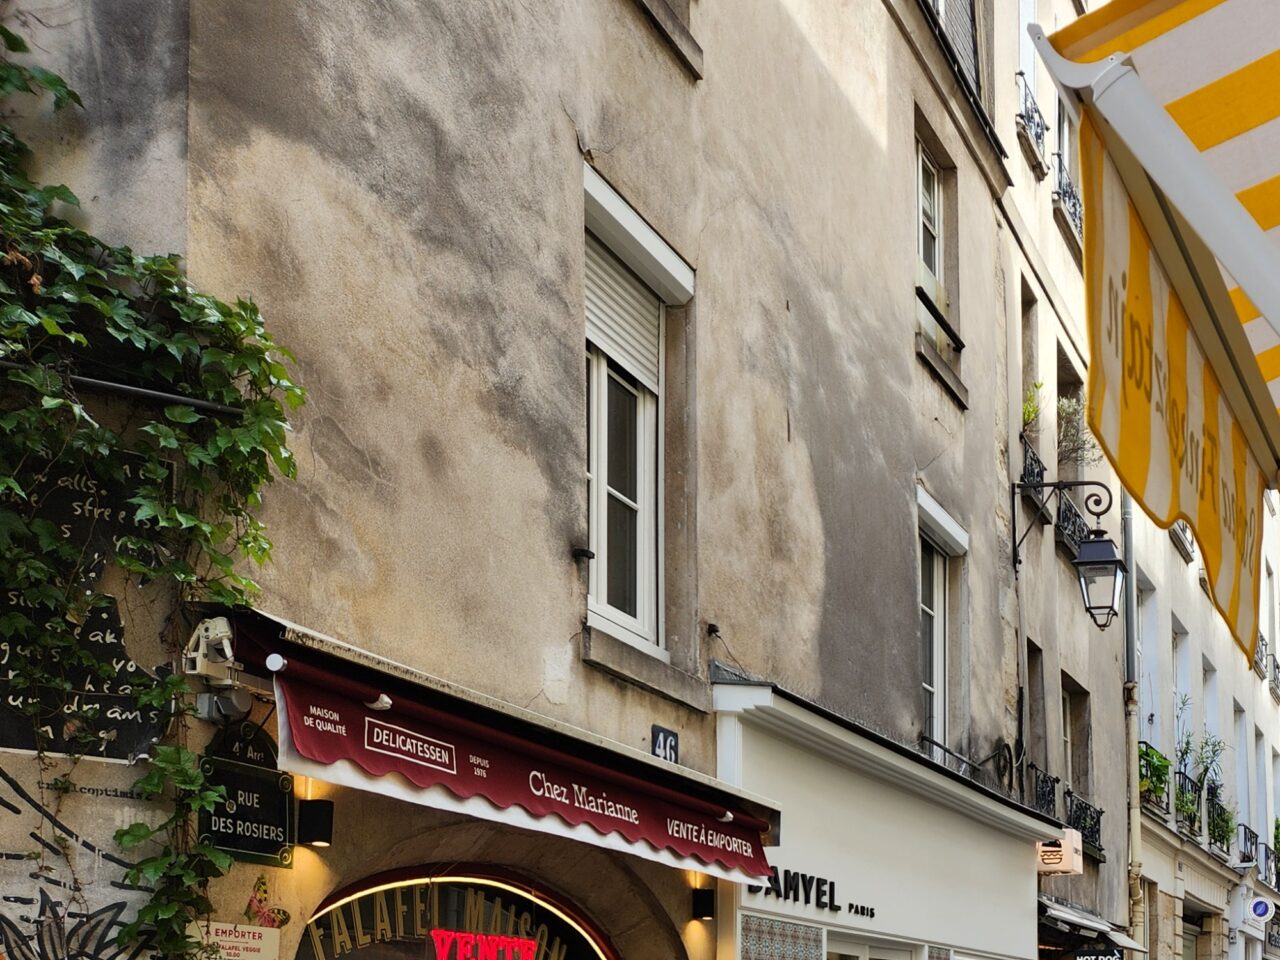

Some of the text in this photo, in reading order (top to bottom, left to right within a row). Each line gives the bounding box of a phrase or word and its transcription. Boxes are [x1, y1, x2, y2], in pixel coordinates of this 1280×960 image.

[310, 705, 340, 722] MAISON
[304, 716, 347, 737] DE QUALITÉ
[373, 727, 449, 765] DELICATESSEN
[655, 732, 675, 763] 46
[469, 754, 490, 769] DEPUIS
[473, 766, 487, 779] 1976
[238, 790, 260, 808] RUE
[528, 770, 639, 825] Chez Marianne
[211, 816, 284, 842] DES ROSIERS
[666, 818, 699, 843] VENTE
[708, 832, 754, 859] EMPORTER
[748, 866, 875, 918] AMYEL PARIS
[215, 928, 263, 941] EMPORTER
